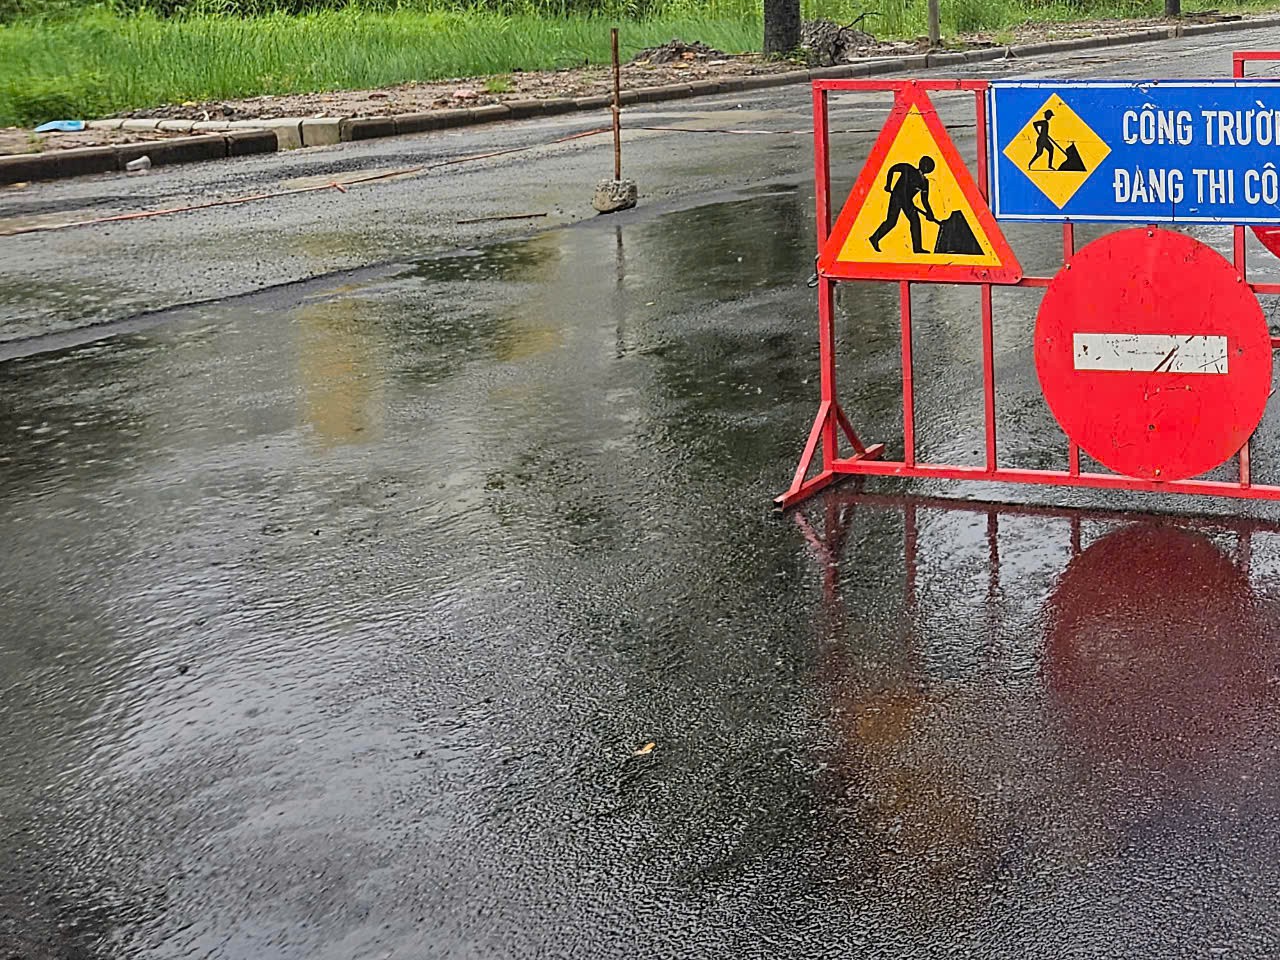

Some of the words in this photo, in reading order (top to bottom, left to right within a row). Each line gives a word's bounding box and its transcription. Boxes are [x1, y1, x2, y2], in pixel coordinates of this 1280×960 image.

[1122, 102, 1193, 146] CÔNG
[1112, 167, 1184, 204] ĐANG
[1192, 168, 1235, 204] THI
